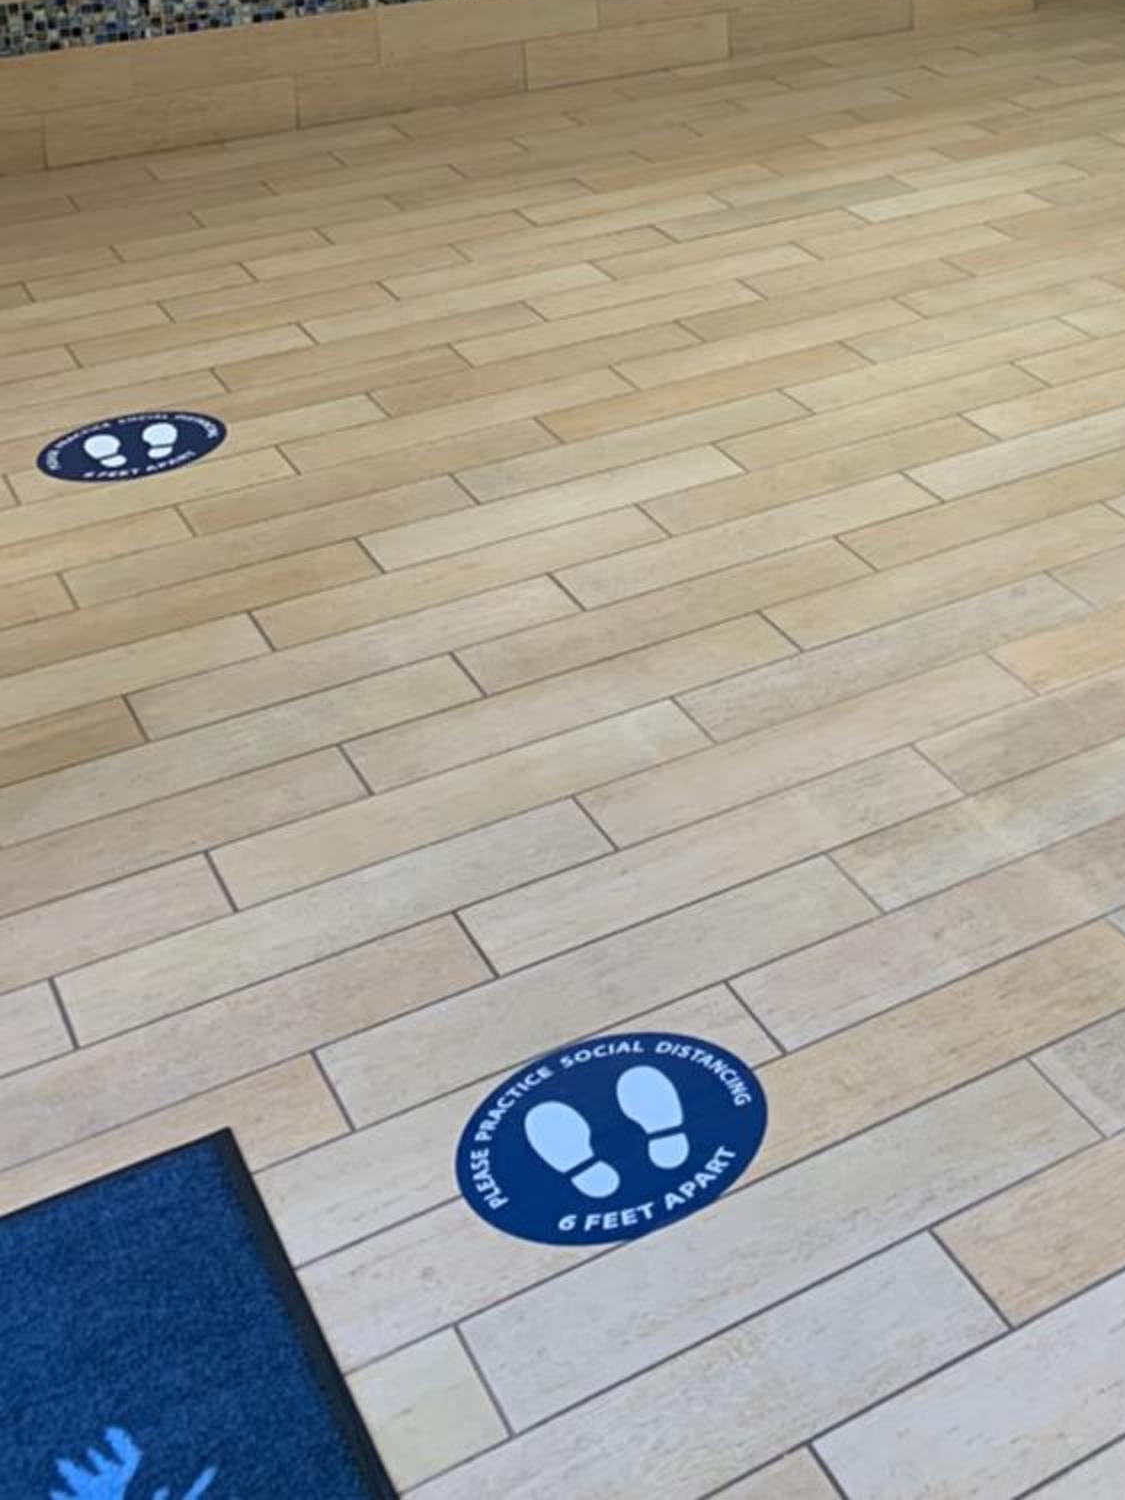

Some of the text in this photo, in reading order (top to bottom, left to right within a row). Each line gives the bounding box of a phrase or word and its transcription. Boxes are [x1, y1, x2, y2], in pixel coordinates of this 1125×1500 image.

[470, 1040, 752, 1211] PLEASE PRACTICE SOCIAL DISTANCING
[557, 1145, 737, 1233] 6 FEET APART
